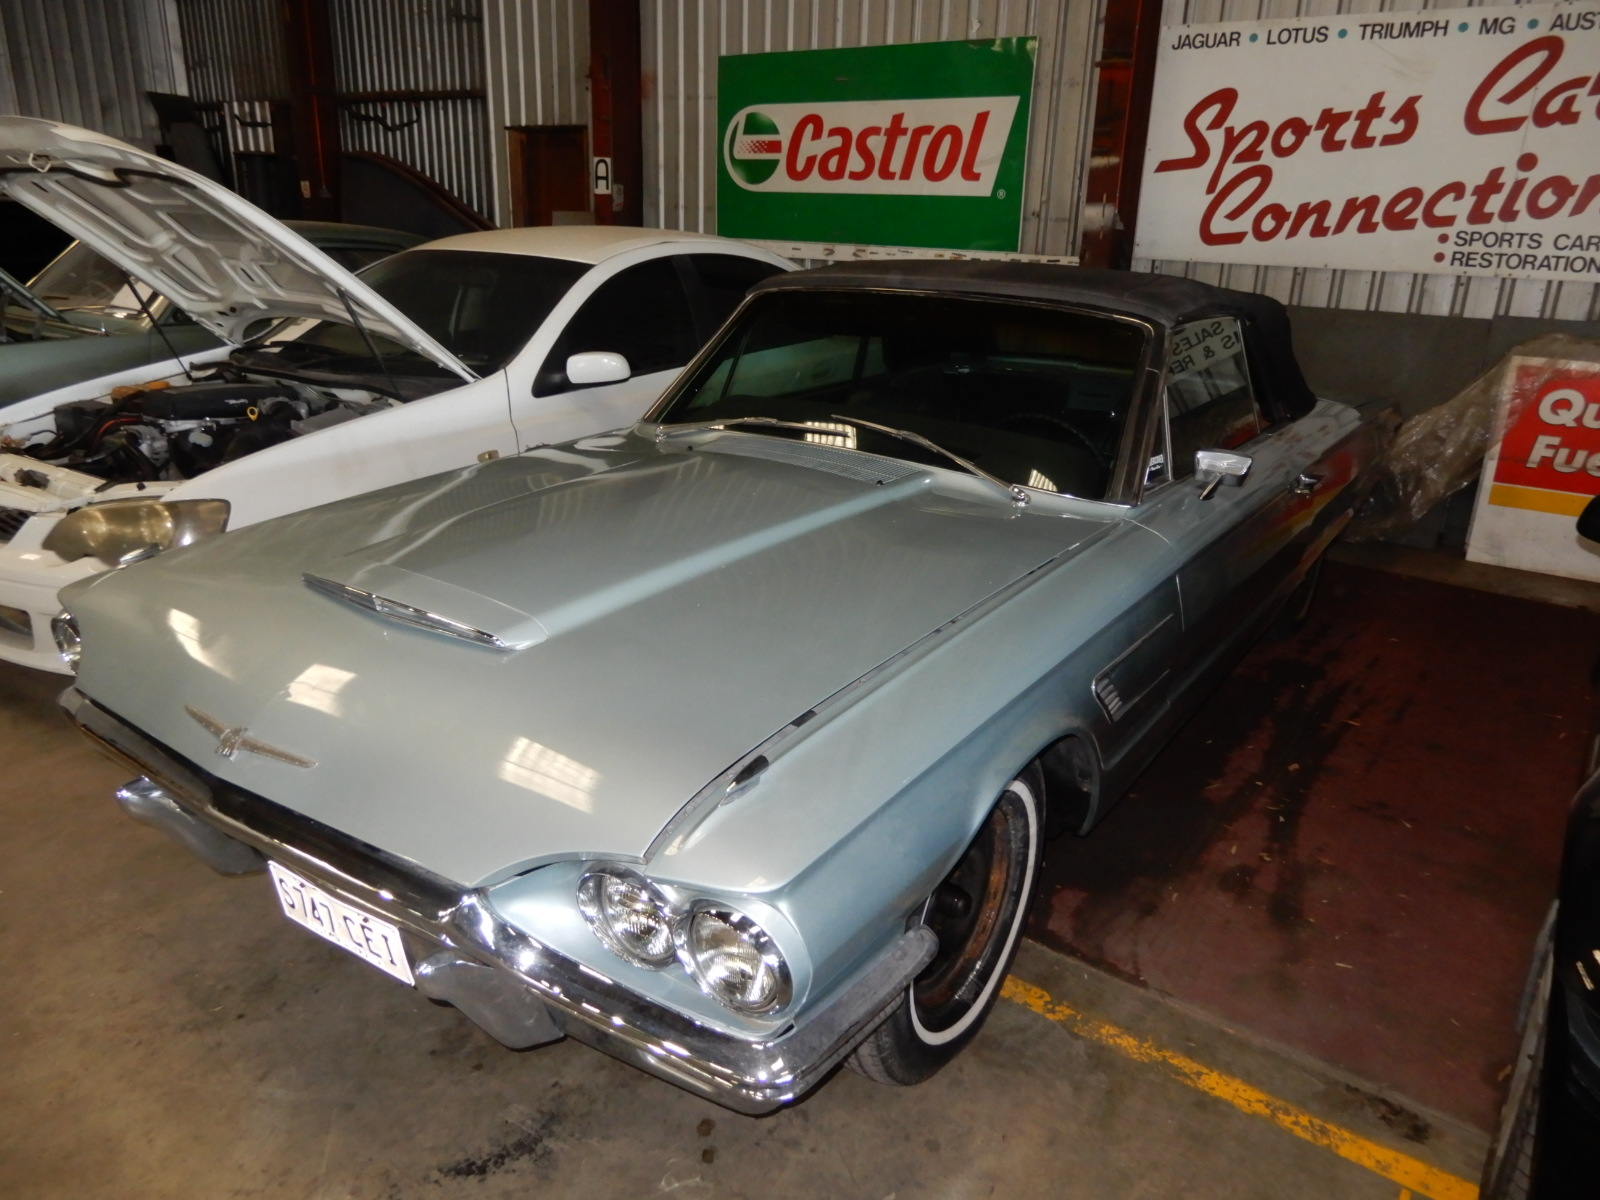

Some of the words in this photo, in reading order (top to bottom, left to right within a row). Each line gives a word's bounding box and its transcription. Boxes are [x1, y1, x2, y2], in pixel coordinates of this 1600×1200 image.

[1171, 32, 1241, 50] JAGUAR
[1266, 26, 1329, 45] LOTUS
[1359, 20, 1449, 41] TRIUMPH
[1478, 16, 1516, 35] MG
[785, 109, 991, 182] Castrol
[1154, 87, 1423, 195] Sports
[595, 158, 609, 190] A
[1199, 152, 1600, 246] Connection
[1450, 251, 1600, 273] RESTORATION
[1453, 230, 1543, 250] SPORTS
[1553, 234, 1600, 252] CAR
[279, 877, 336, 933] S747
